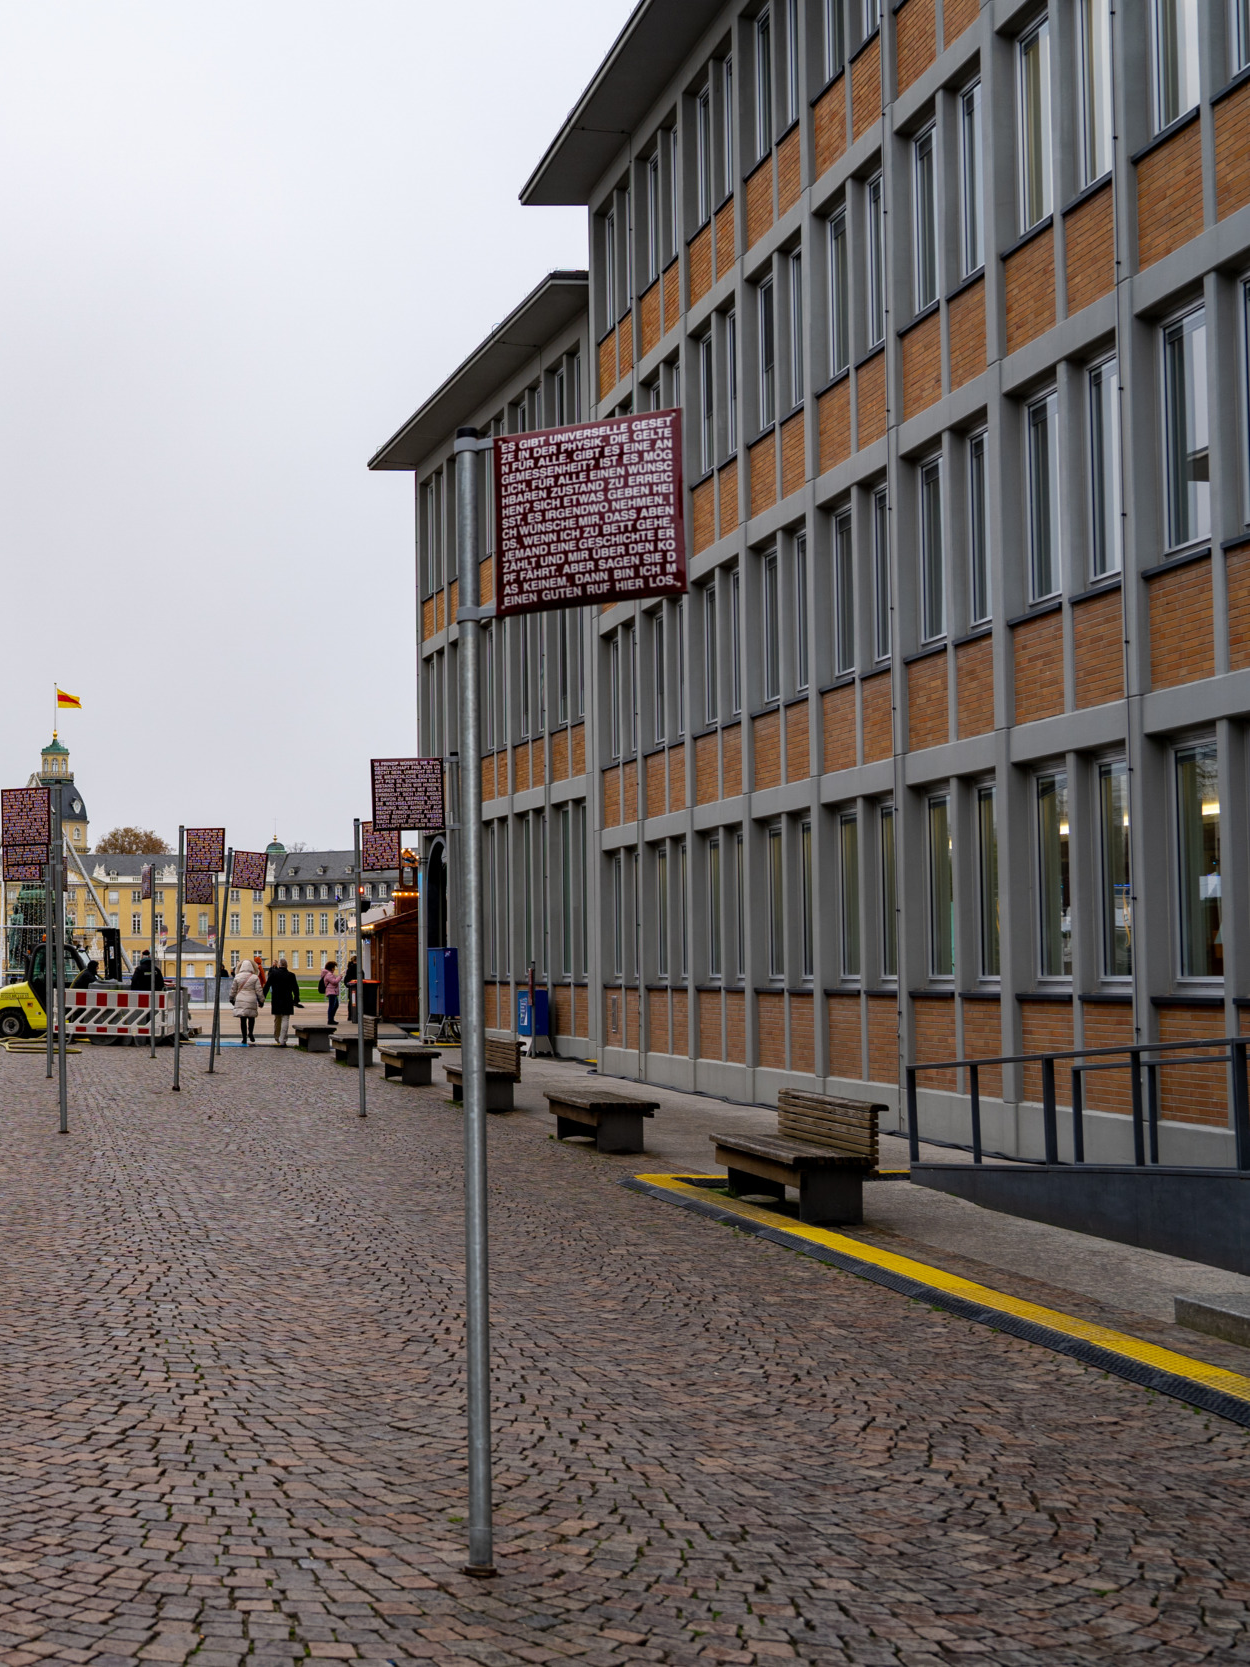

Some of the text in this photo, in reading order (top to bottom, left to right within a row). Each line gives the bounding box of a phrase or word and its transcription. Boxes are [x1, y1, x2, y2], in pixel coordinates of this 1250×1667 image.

[501, 416, 672, 452] ES GIBT UNIVERSELLE GESET
[501, 447, 672, 483] GEMESSENHEIT? IST ES MÖG
[532, 476, 554, 489] FÜR
[557, 472, 586, 485] ALLE
[590, 467, 624, 480] EINEN
[627, 458, 672, 474] WÜNSC
[502, 471, 672, 505] HBAREN ZUSTAND ZU ERREIC
[502, 482, 673, 516] HEN? SICH ETWAS GEBEN HEI
[502, 505, 673, 537] CH WÜNSCHE MIR, DASS ABEN
[502, 528, 674, 560] JEMAND EINE GESCHICHTE ER
[504, 575, 677, 605] EINEN GUTEN RUF HIER LOS.
